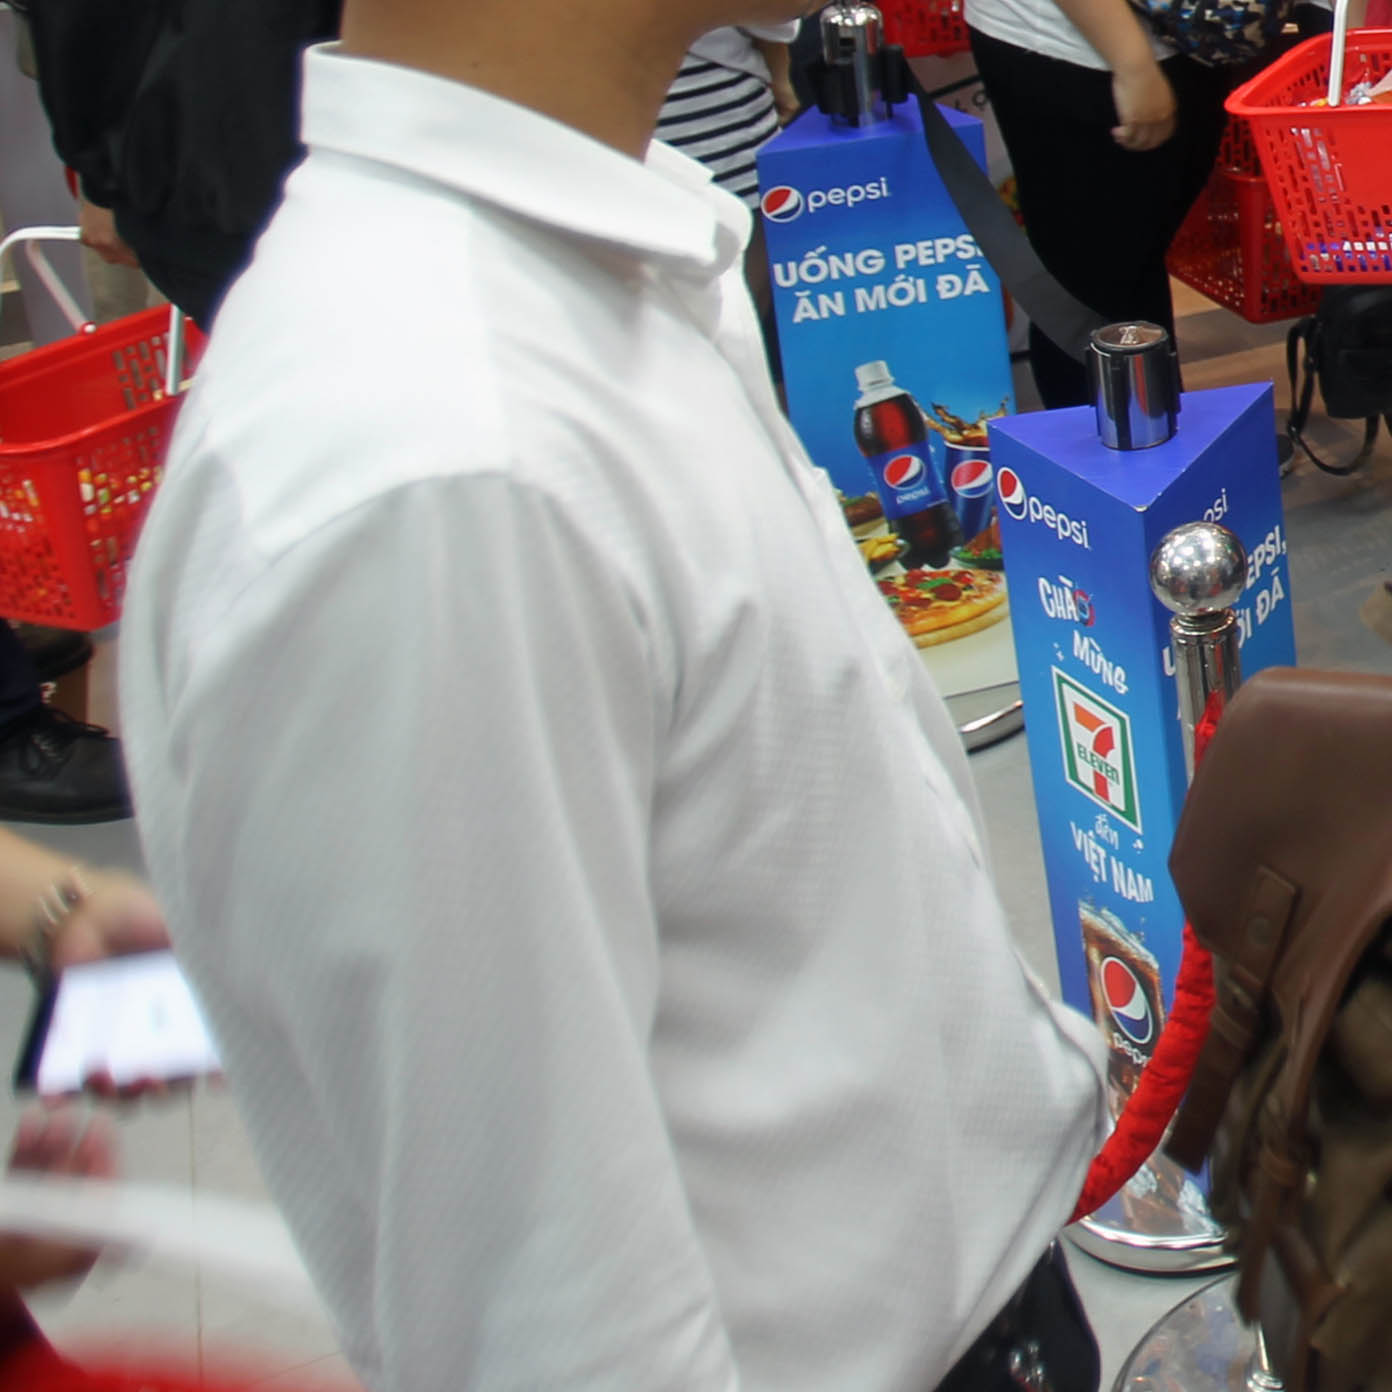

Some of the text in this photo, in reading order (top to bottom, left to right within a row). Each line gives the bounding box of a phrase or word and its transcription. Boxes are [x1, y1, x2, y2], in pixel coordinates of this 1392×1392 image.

[807, 177, 888, 213] pepsi
[773, 234, 984, 287] UỐNG PEPS
[854, 274, 927, 313] MỚI
[1029, 497, 1091, 549] pepsi
[1070, 821, 1154, 903] VIỆT NAM
